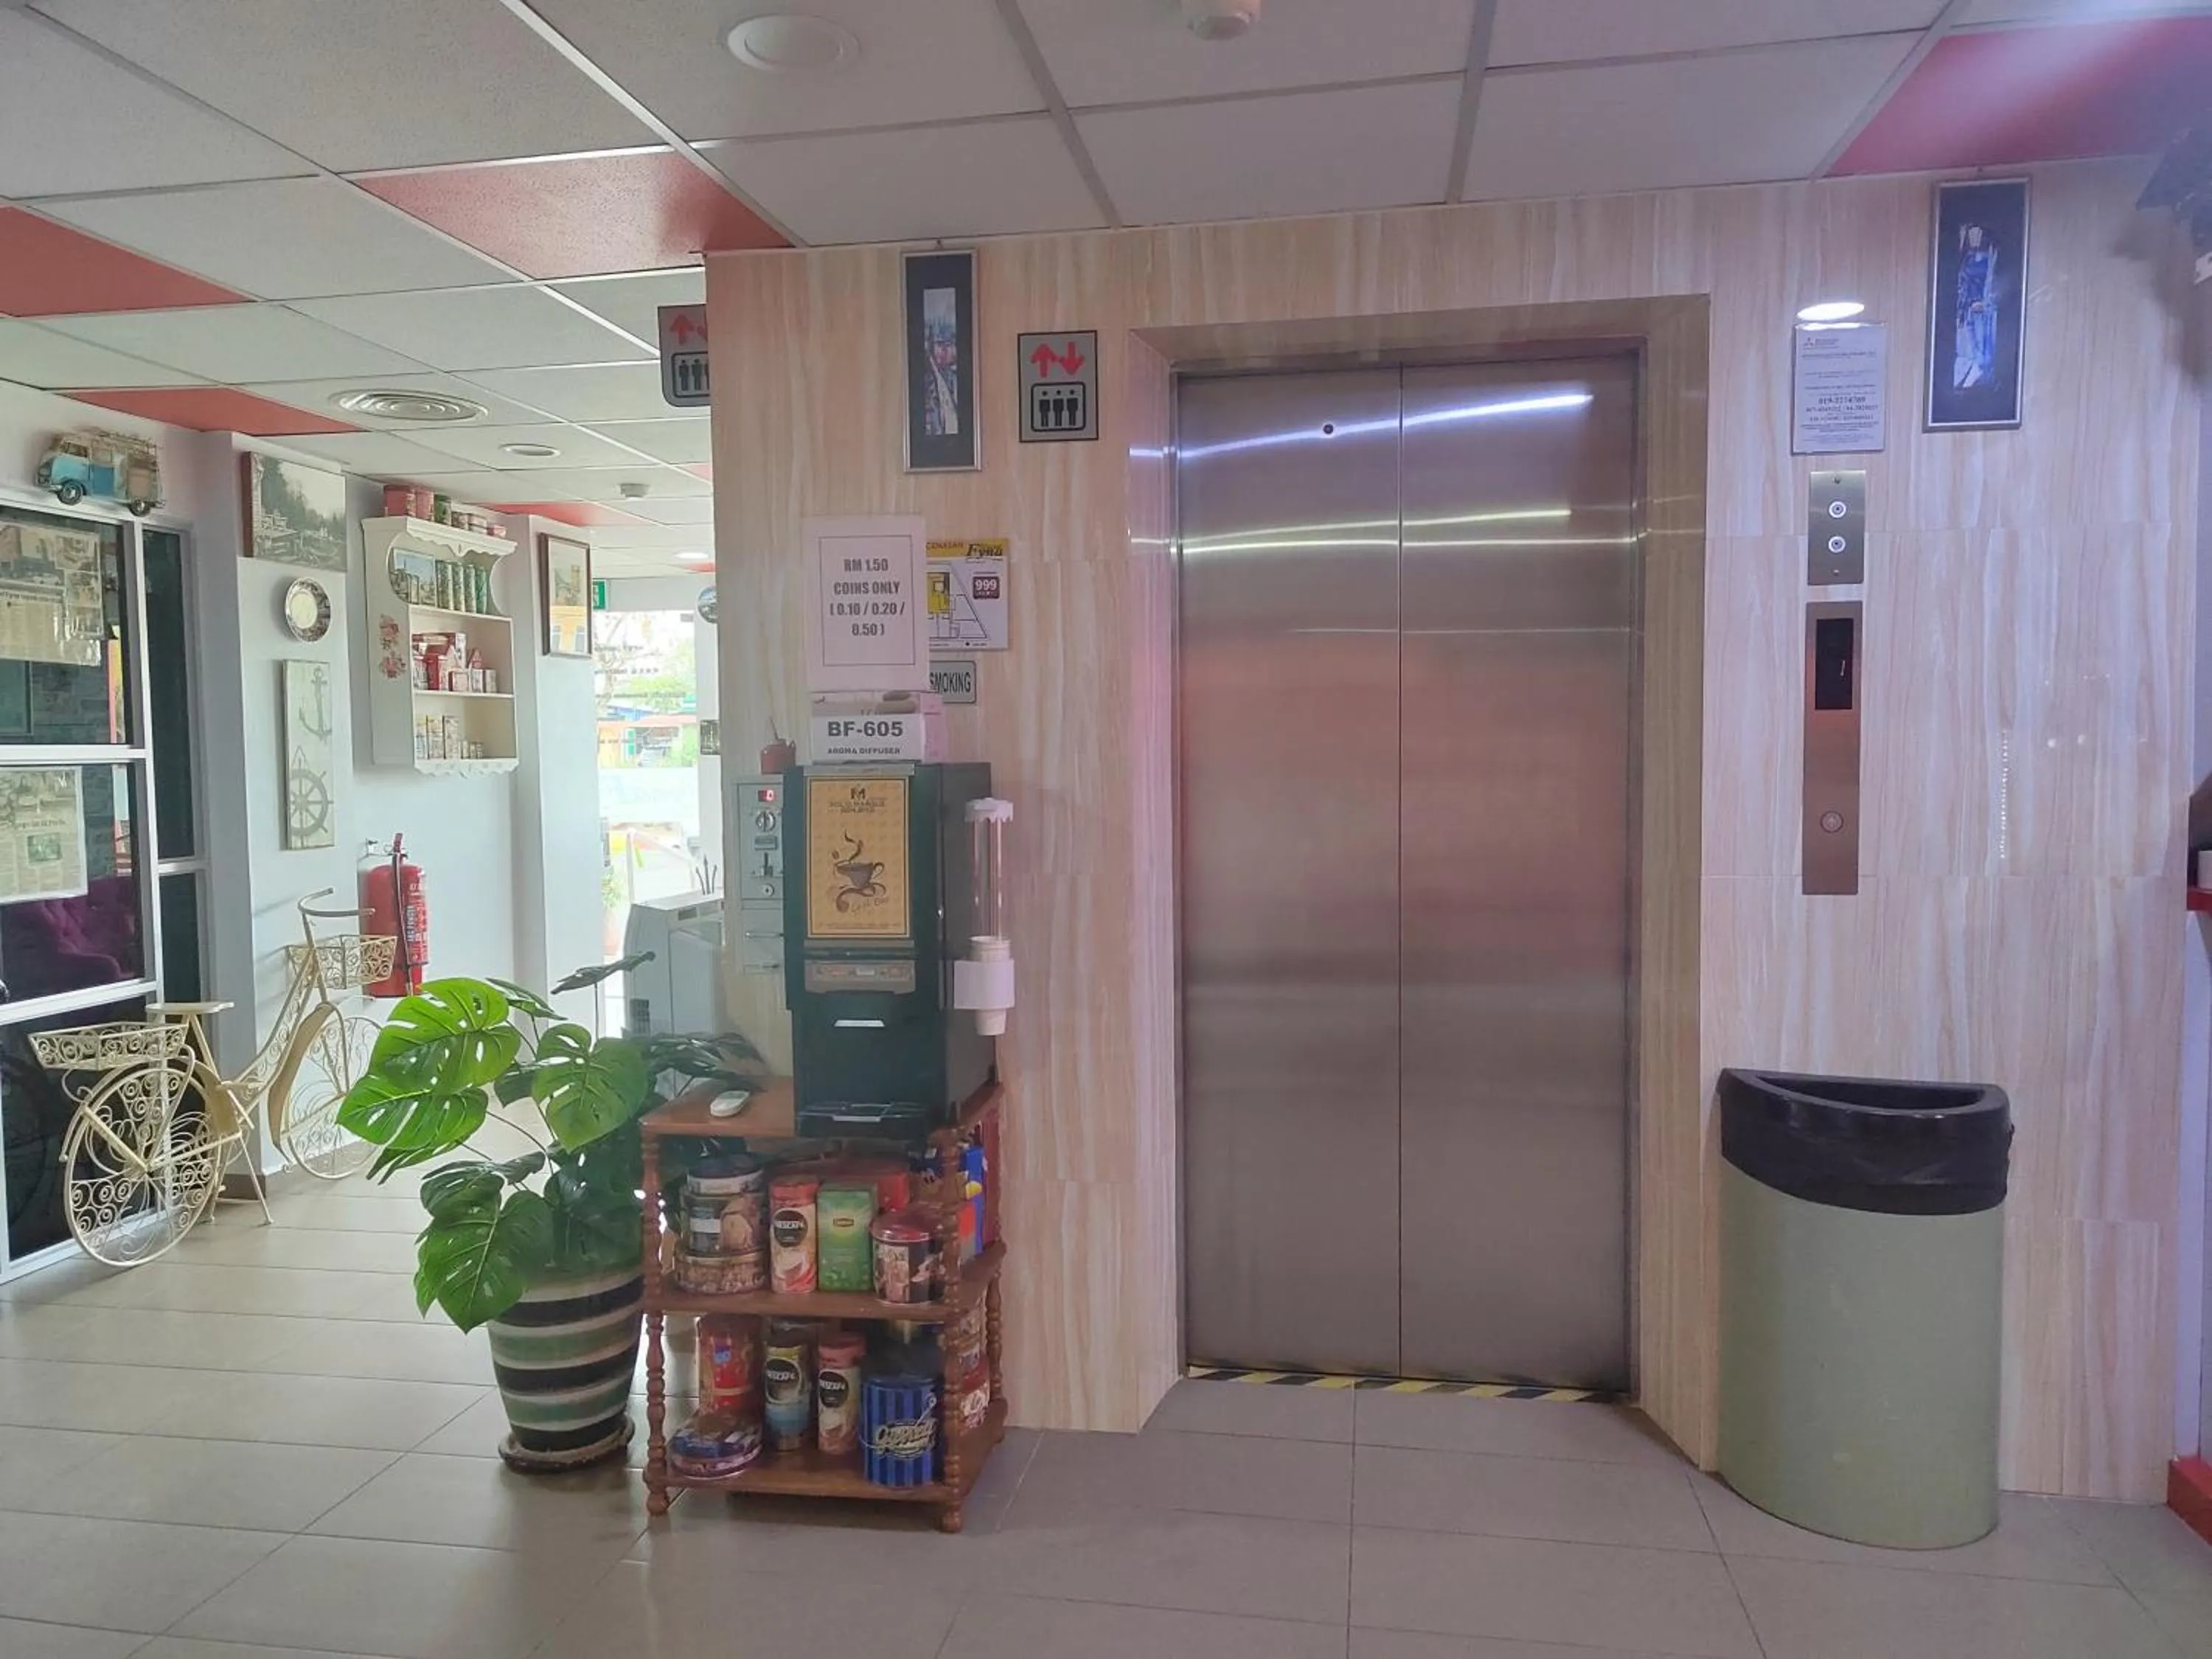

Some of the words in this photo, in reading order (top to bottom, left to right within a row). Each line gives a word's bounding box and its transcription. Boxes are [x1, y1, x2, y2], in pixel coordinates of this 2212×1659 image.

[844, 558, 862, 572] RM
[866, 558, 888, 571] 1.50
[834, 582, 869, 595] COINS
[872, 581, 900, 594] ONLY
[975, 579, 998, 591] 999
[837, 602, 860, 616] 0.10
[872, 602, 897, 615] 0.20
[852, 623, 877, 636] 0.50
[929, 672, 971, 693] SMOKING
[827, 720, 903, 737] BF-605
